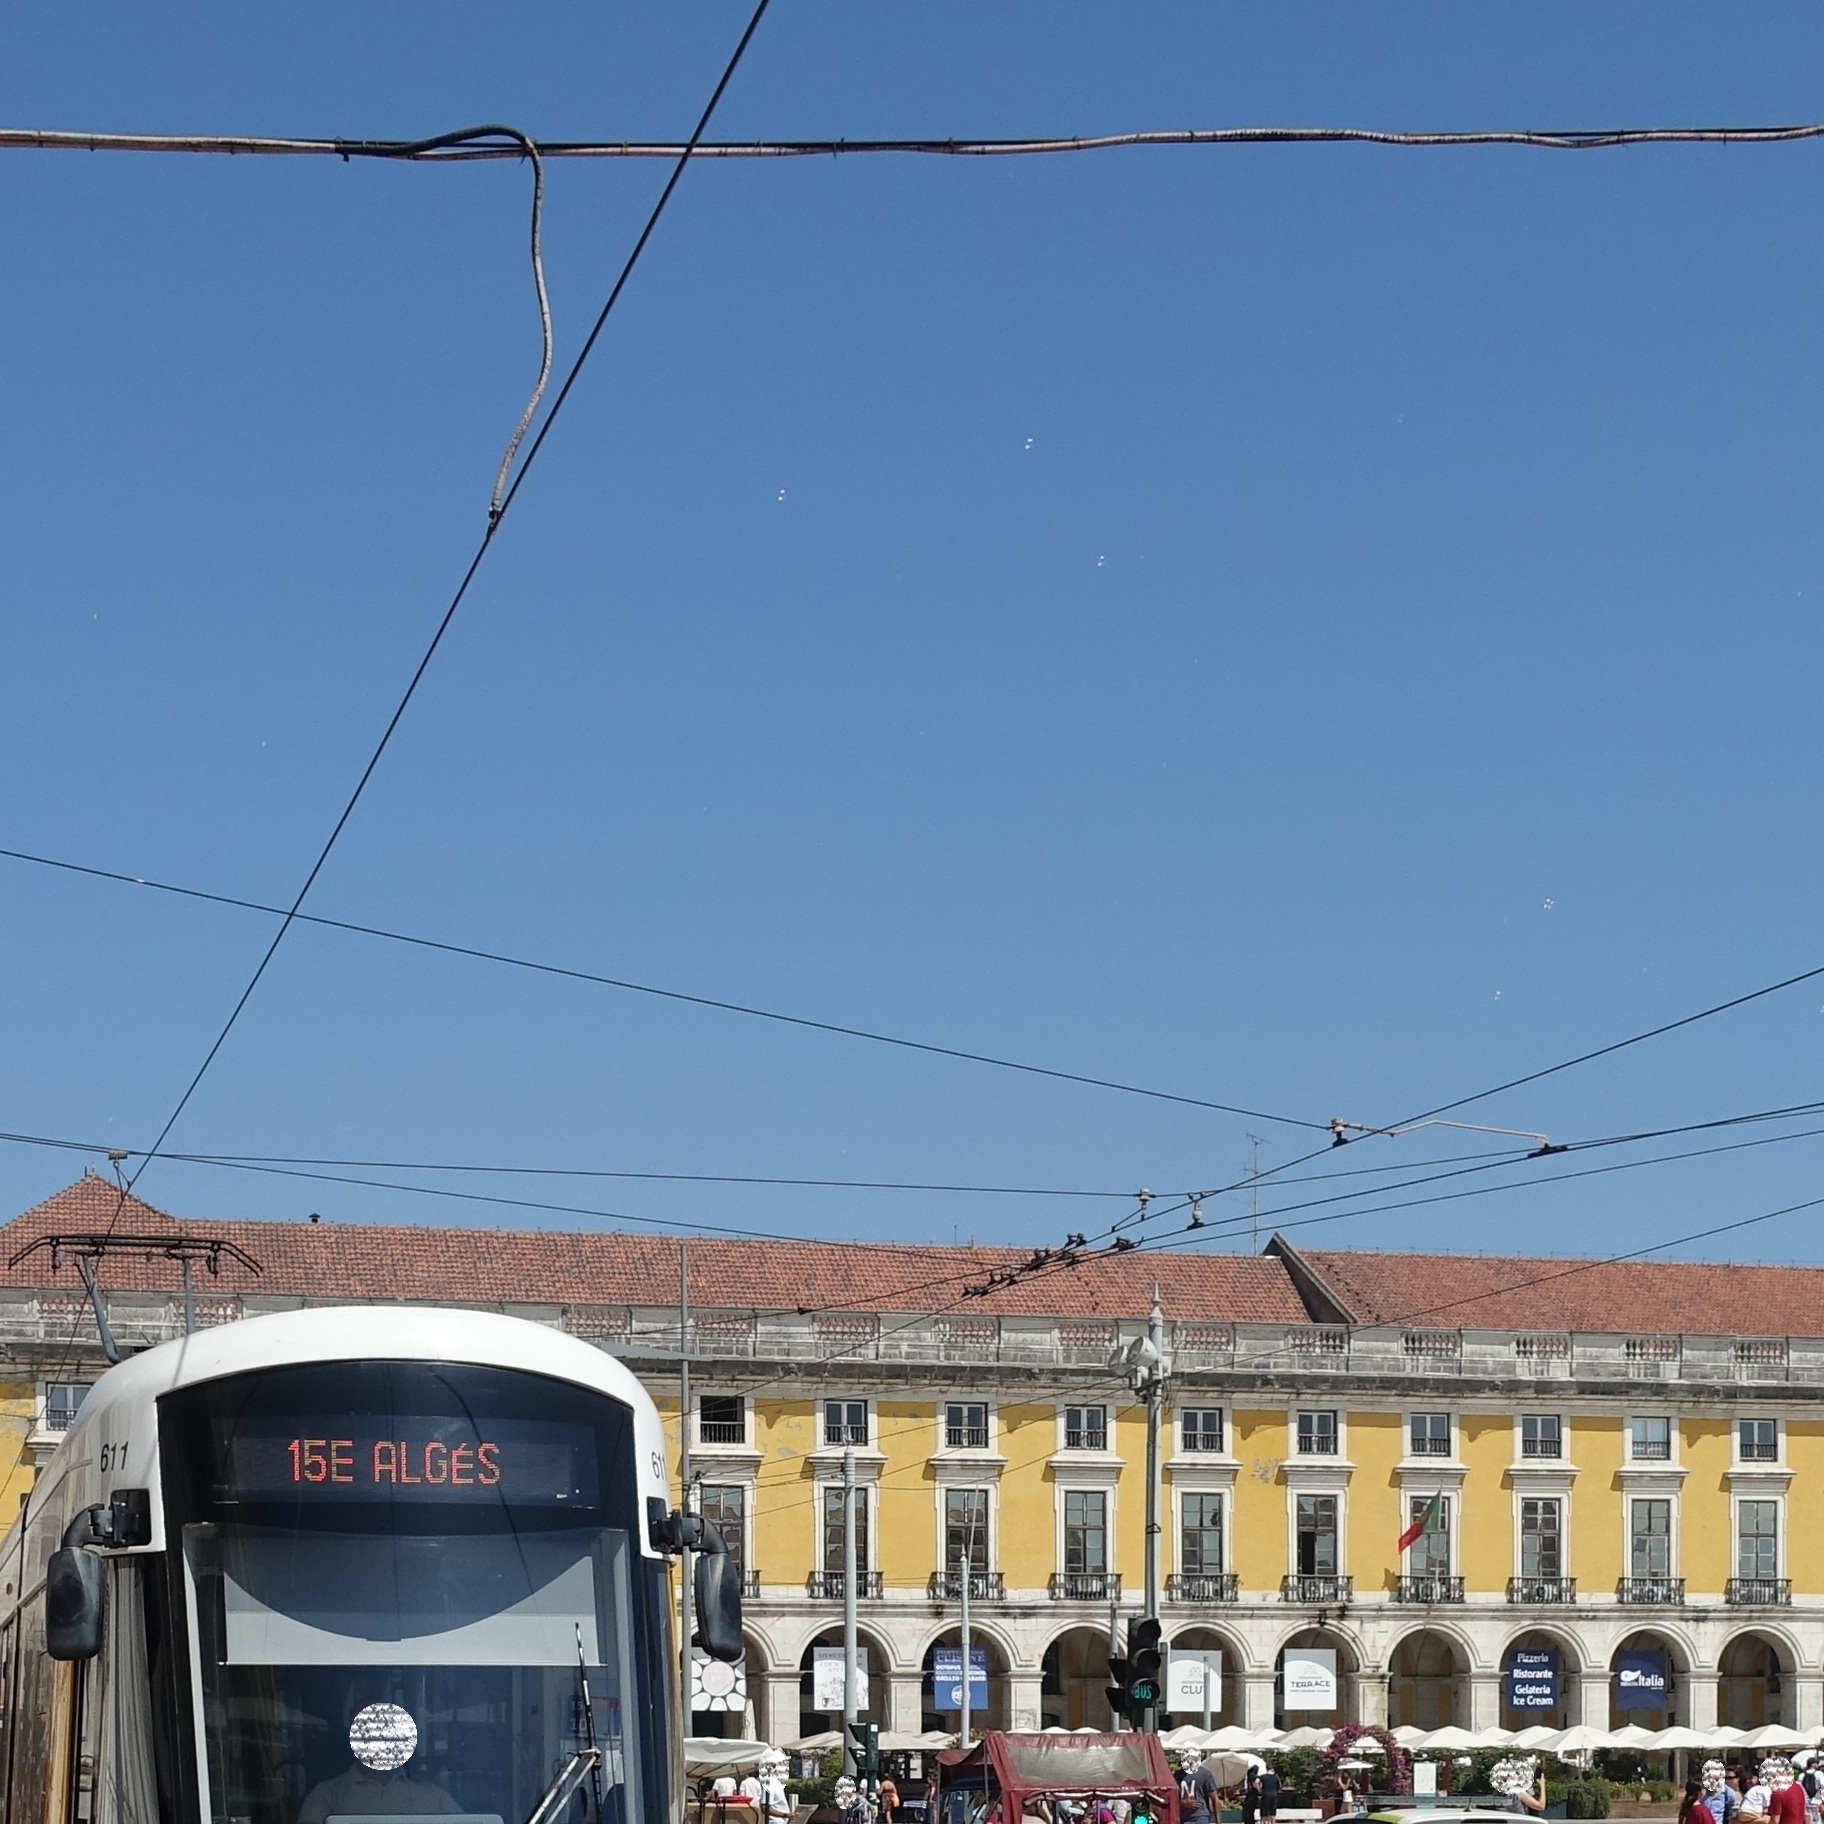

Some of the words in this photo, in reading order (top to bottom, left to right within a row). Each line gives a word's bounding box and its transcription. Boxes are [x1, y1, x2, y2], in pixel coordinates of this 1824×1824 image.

[100, 1440, 129, 1474] 611
[287, 1439, 354, 1482] 15E
[374, 1440, 501, 1485] ALGÉS
[1517, 1652, 1549, 1663] Pizzeria
[1513, 1668, 1554, 1679] Ristorante
[1290, 1680, 1331, 1688] TERRACE
[1515, 1684, 1551, 1694] Gelateria
[1133, 1684, 1153, 1700] BUS
[1180, 1685, 1203, 1695] CLU
[1513, 1695, 1525, 1706] Ice
[1526, 1695, 1554, 1706] Cream
